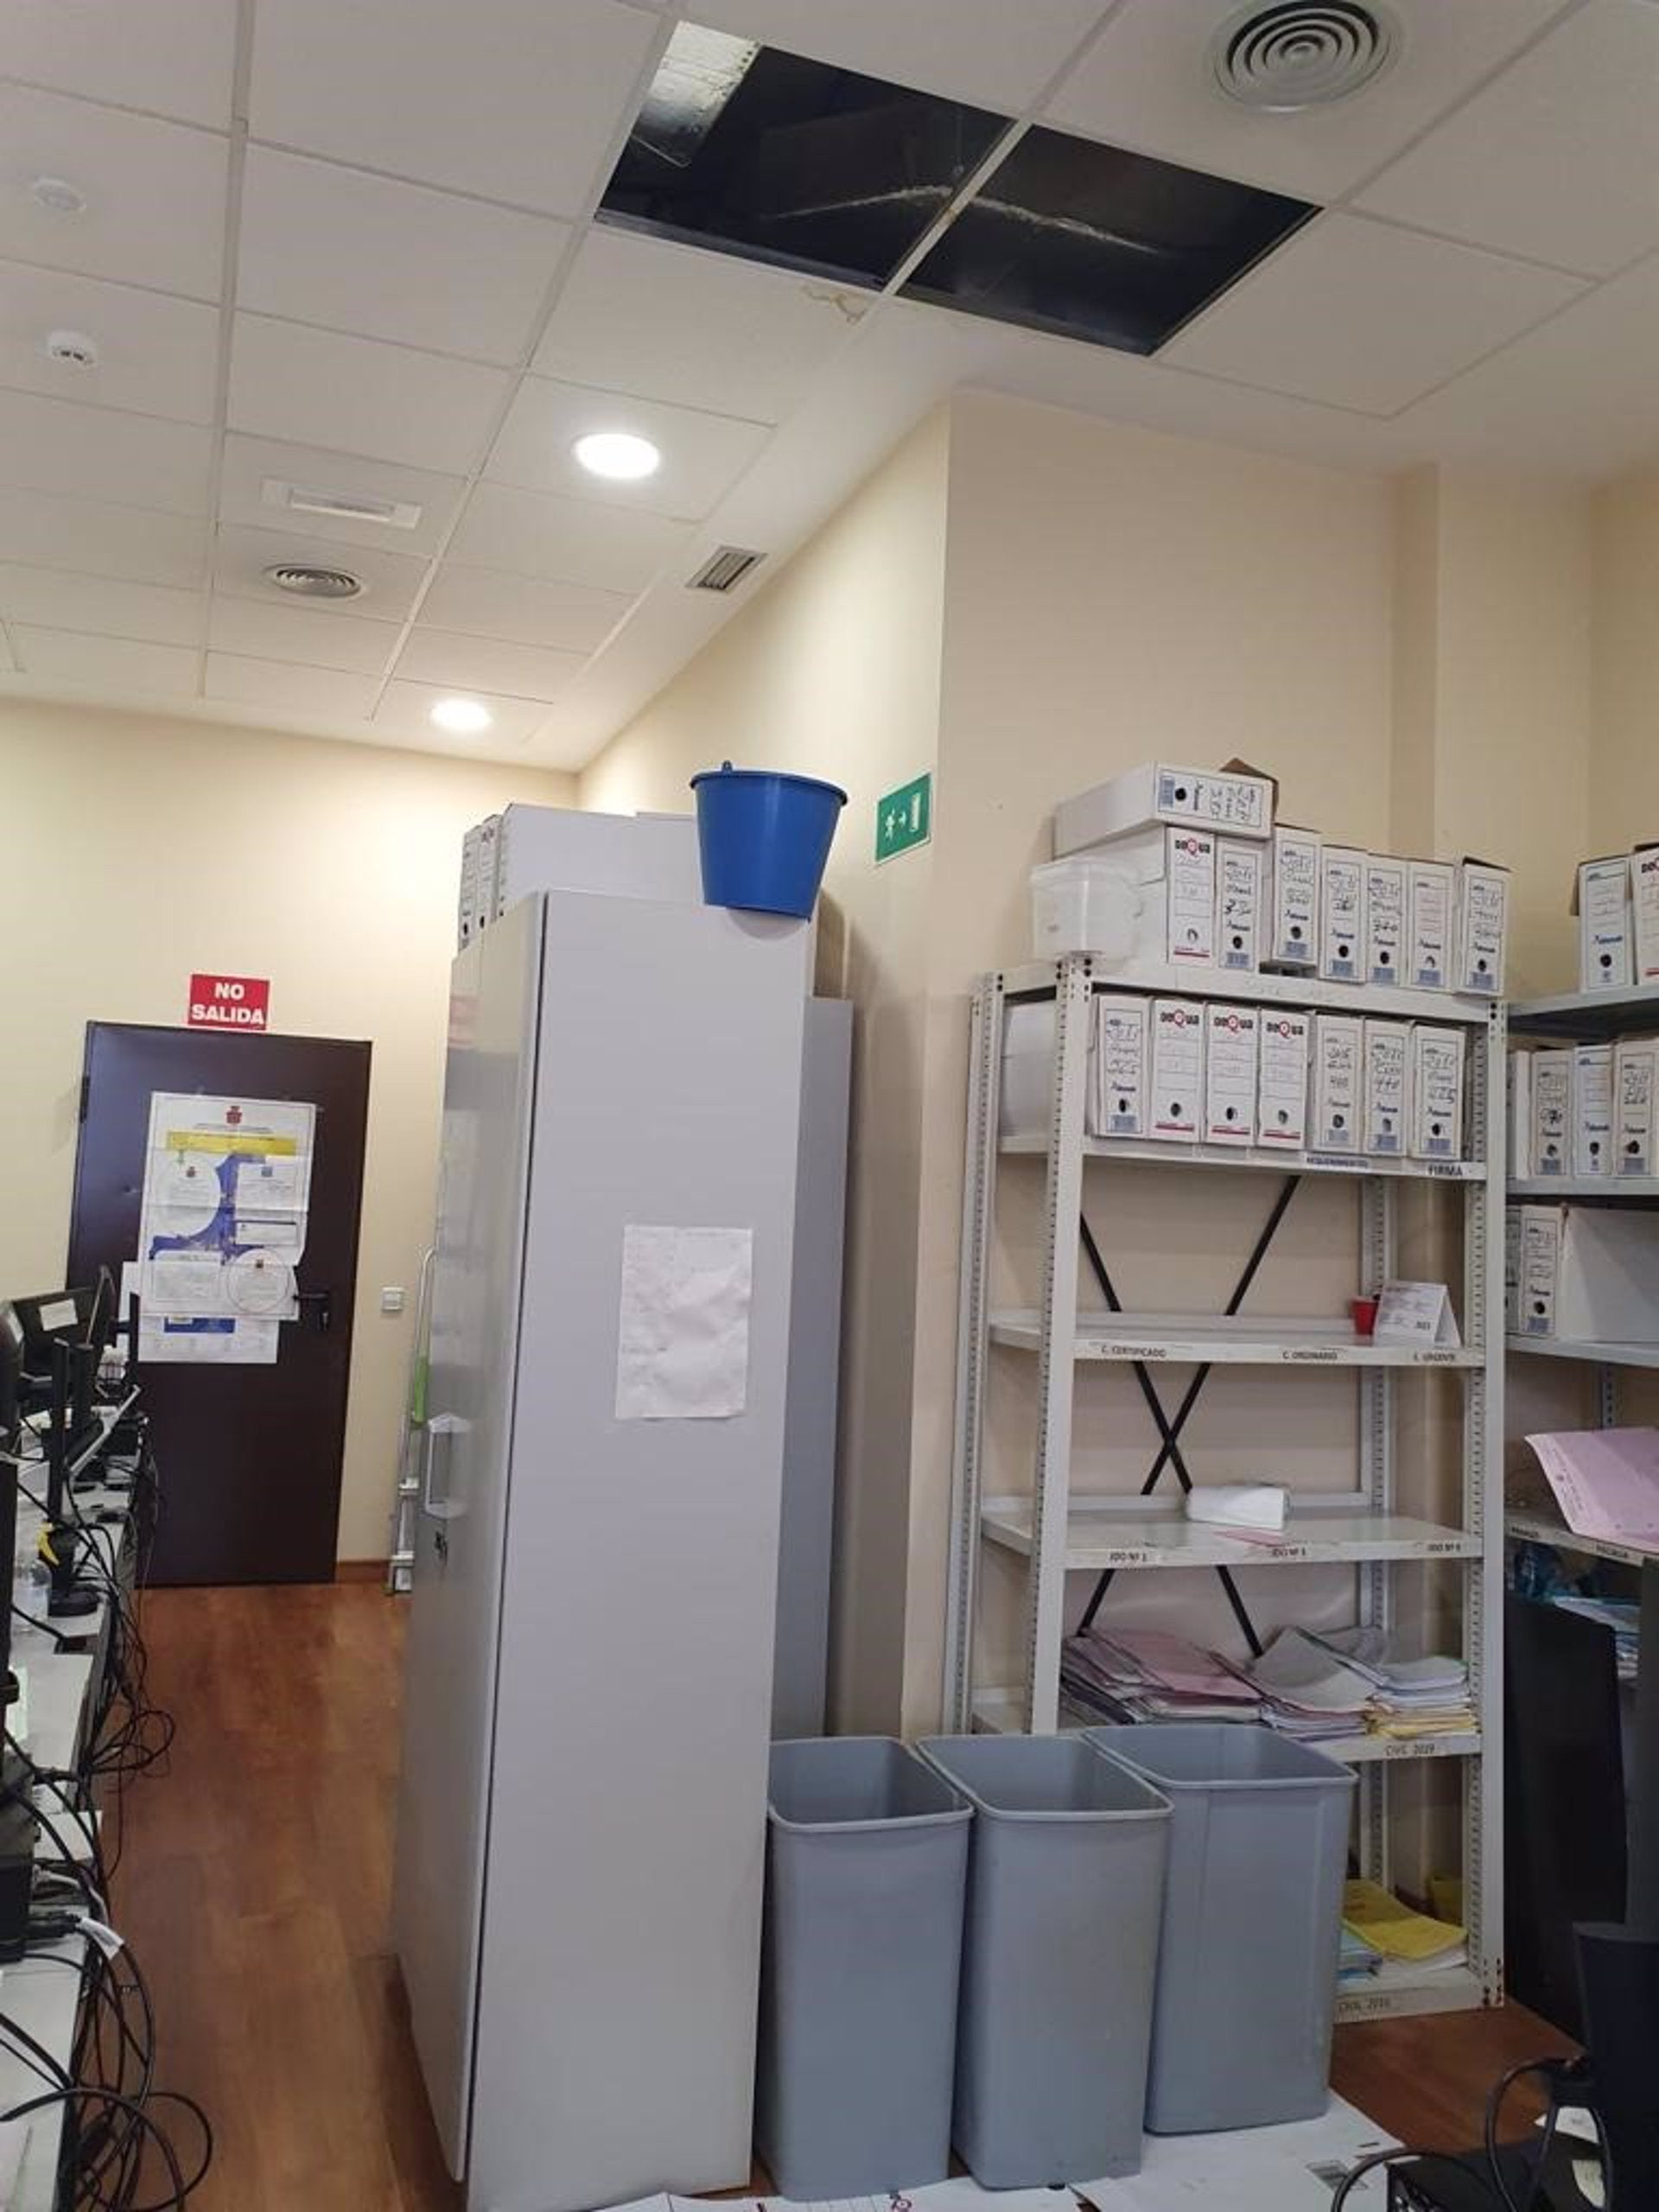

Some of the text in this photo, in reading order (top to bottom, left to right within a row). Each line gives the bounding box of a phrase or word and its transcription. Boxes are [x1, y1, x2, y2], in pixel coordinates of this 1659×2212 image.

[214, 982, 245, 1001] NO
[191, 1003, 264, 1025] SALIDA
[1428, 1165, 1464, 1176] FIRMA
[1111, 1345, 1166, 1357] CERTIFICADO
